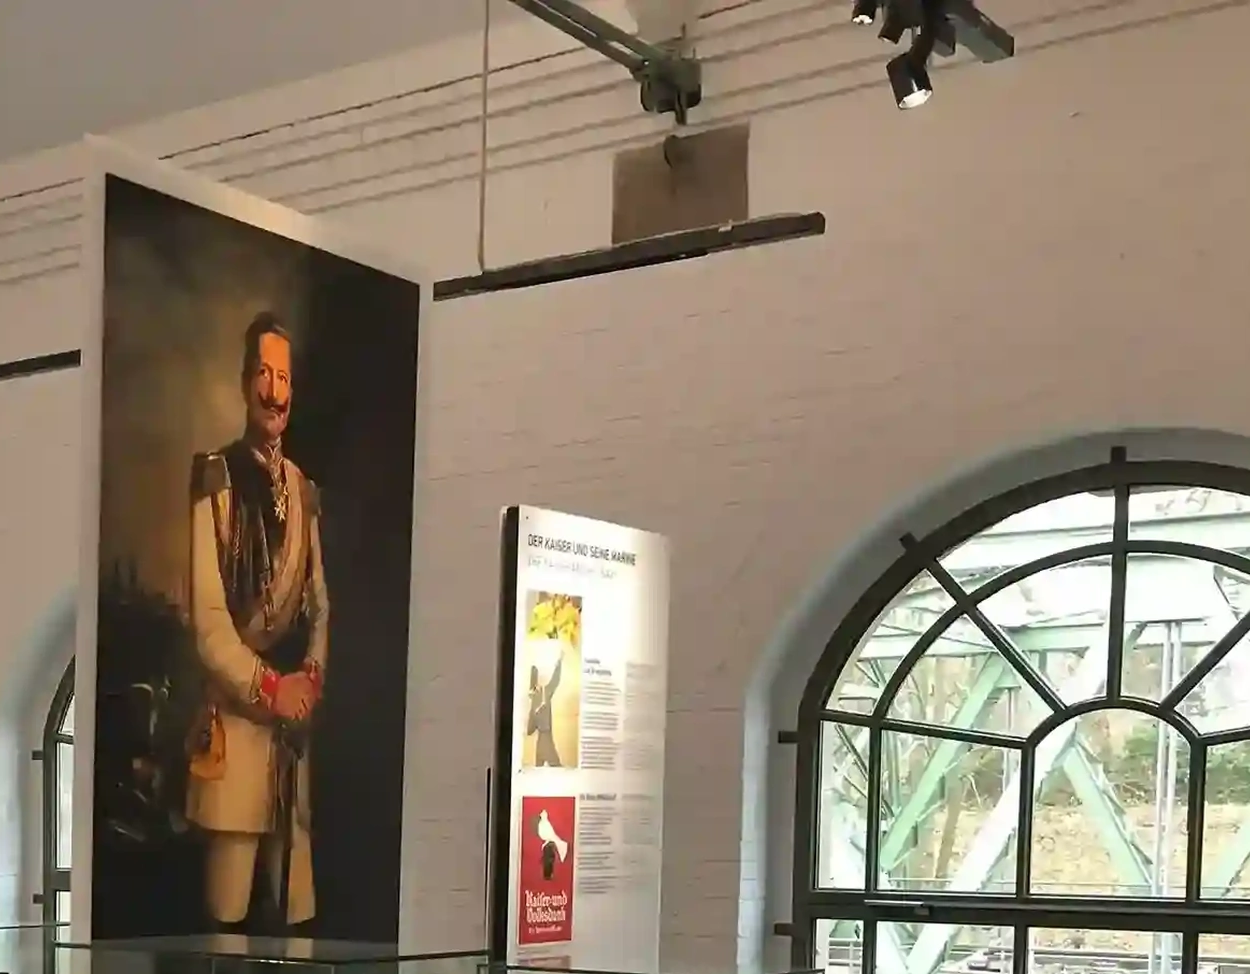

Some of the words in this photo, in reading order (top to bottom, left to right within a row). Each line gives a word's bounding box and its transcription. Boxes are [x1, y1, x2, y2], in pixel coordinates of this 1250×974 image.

[528, 533, 543, 548] DER
[544, 536, 572, 554] KAISER
[572, 540, 588, 557] UND
